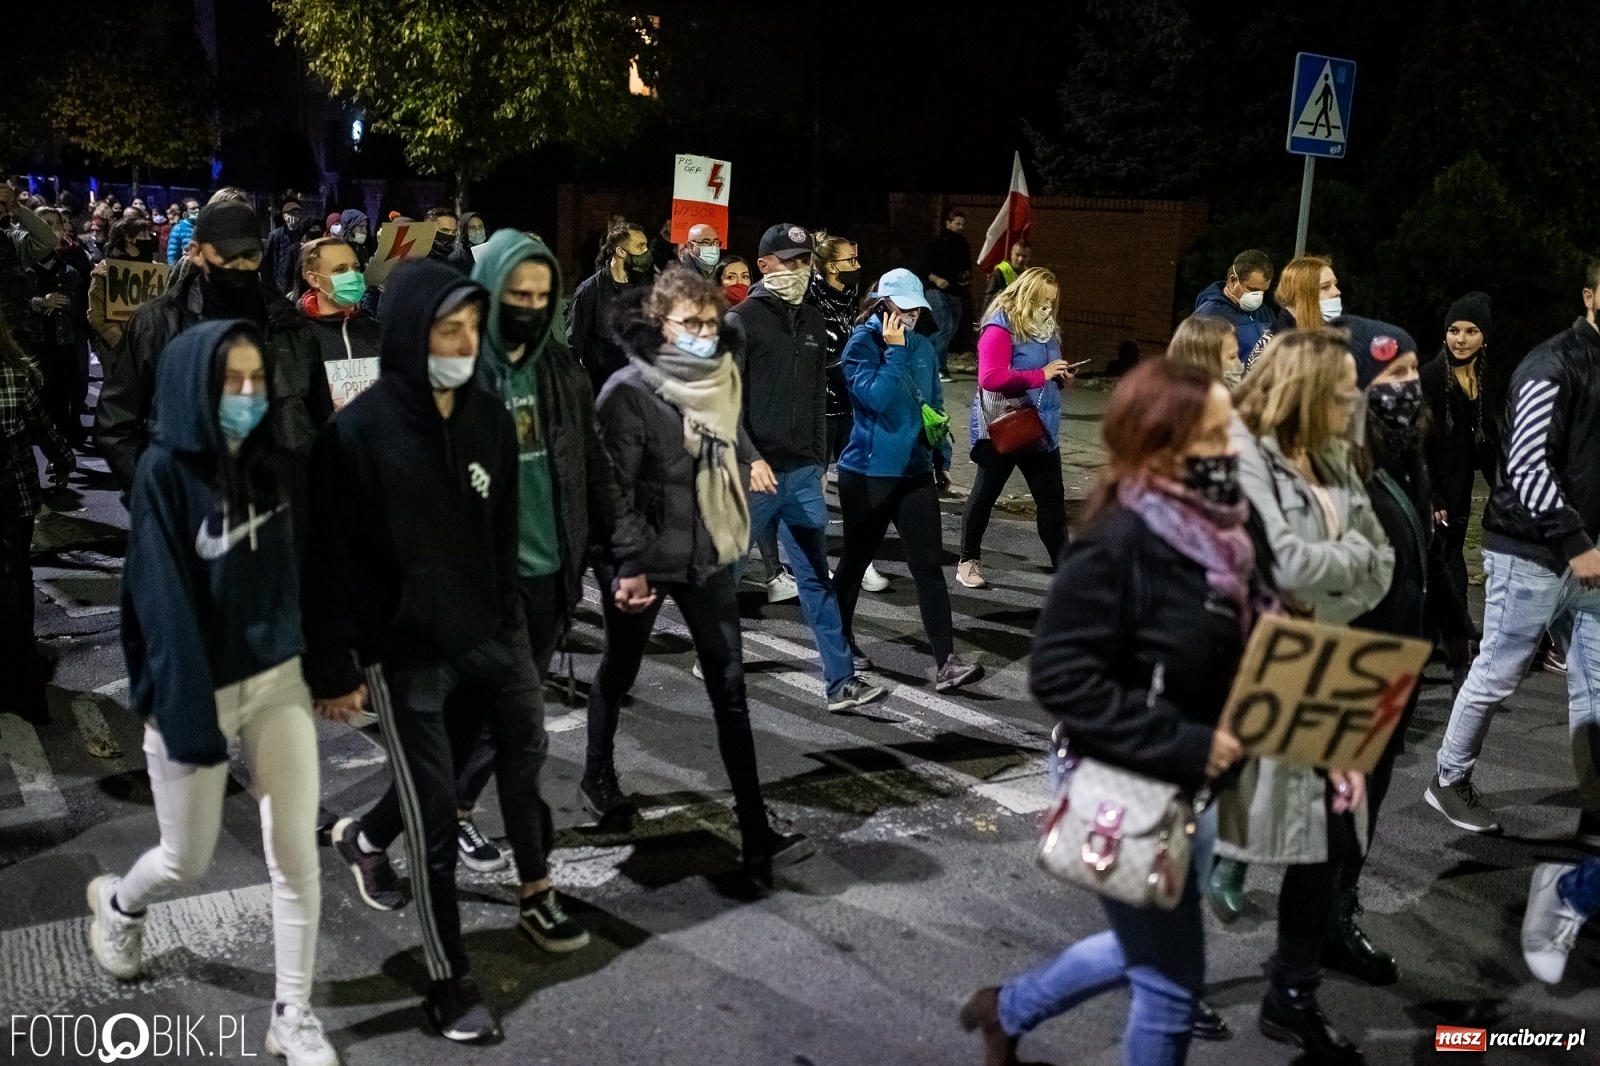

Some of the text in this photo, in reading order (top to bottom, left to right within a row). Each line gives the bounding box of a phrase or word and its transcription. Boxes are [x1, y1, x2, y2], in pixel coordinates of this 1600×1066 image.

[678, 157, 693, 166] PIS
[683, 165, 702, 175] OFF
[673, 202, 716, 219] WYBÓR
[1254, 627, 1404, 698] PIS
[1231, 690, 1377, 761] OFF
